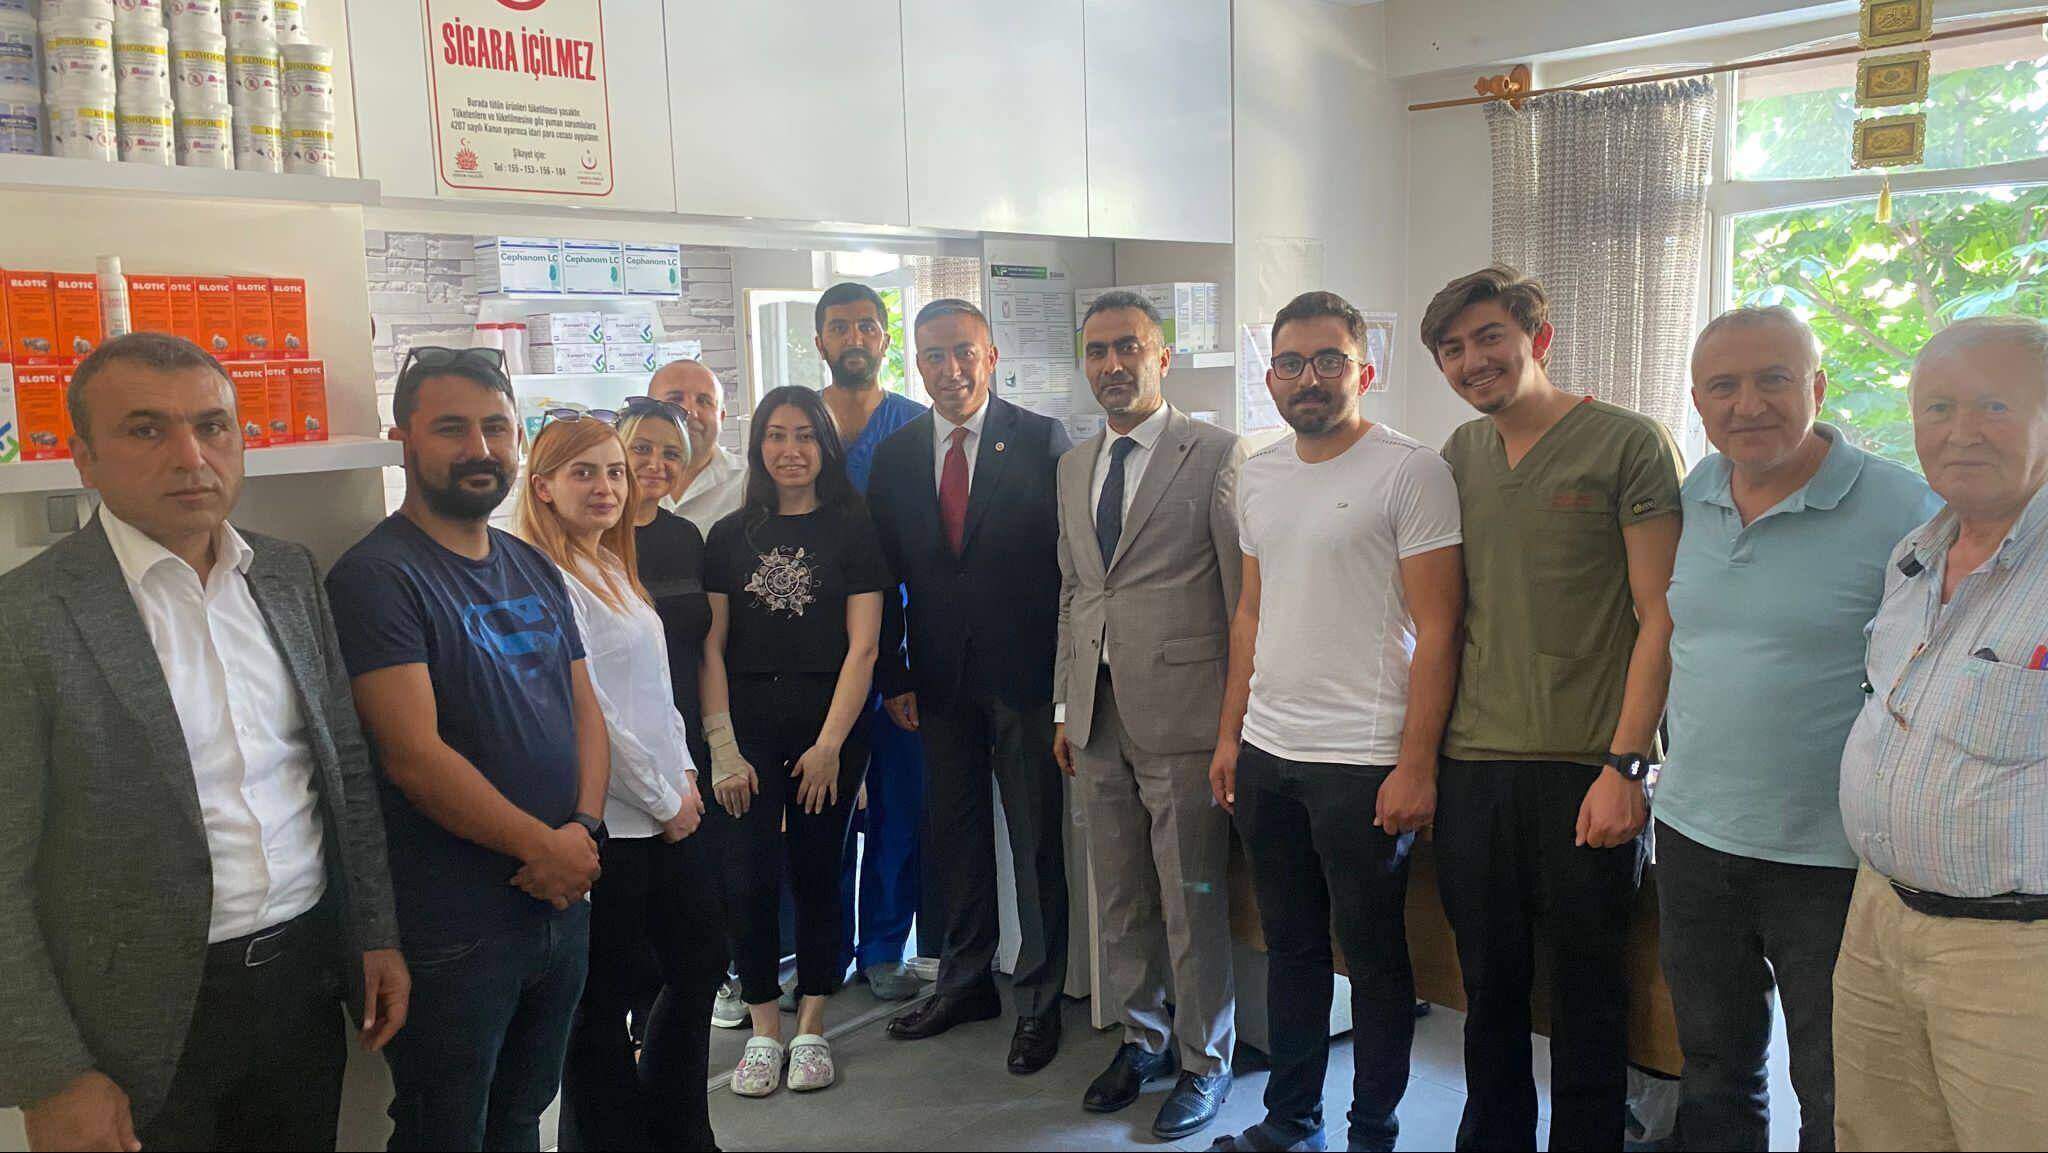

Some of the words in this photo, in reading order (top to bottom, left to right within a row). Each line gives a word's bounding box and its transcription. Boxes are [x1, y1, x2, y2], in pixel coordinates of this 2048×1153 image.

[442, 17, 518, 72] SİGARA
[521, 26, 596, 81] İÇİLMEZ
[500, 252, 546, 263] Cephanom
[547, 254, 558, 263] LC
[565, 255, 607, 265] Cephanom
[609, 256, 620, 264] LC
[626, 256, 666, 266] Cephanom
[667, 258, 678, 266] LC
[11, 279, 48, 288] BLOTIC
[58, 280, 94, 289] BLOTIC
[132, 282, 166, 291] BLOTIC
[170, 283, 192, 292] OTIC
[199, 283, 230, 292] BLOTIC
[236, 283, 267, 292] BLOTIC
[273, 284, 302, 293] BLOTIC
[232, 369, 264, 378] BLOTIC
[267, 368, 286, 376] OTIC
[292, 366, 321, 375] BLOTIC
[19, 375, 56, 384] BLOTIC
